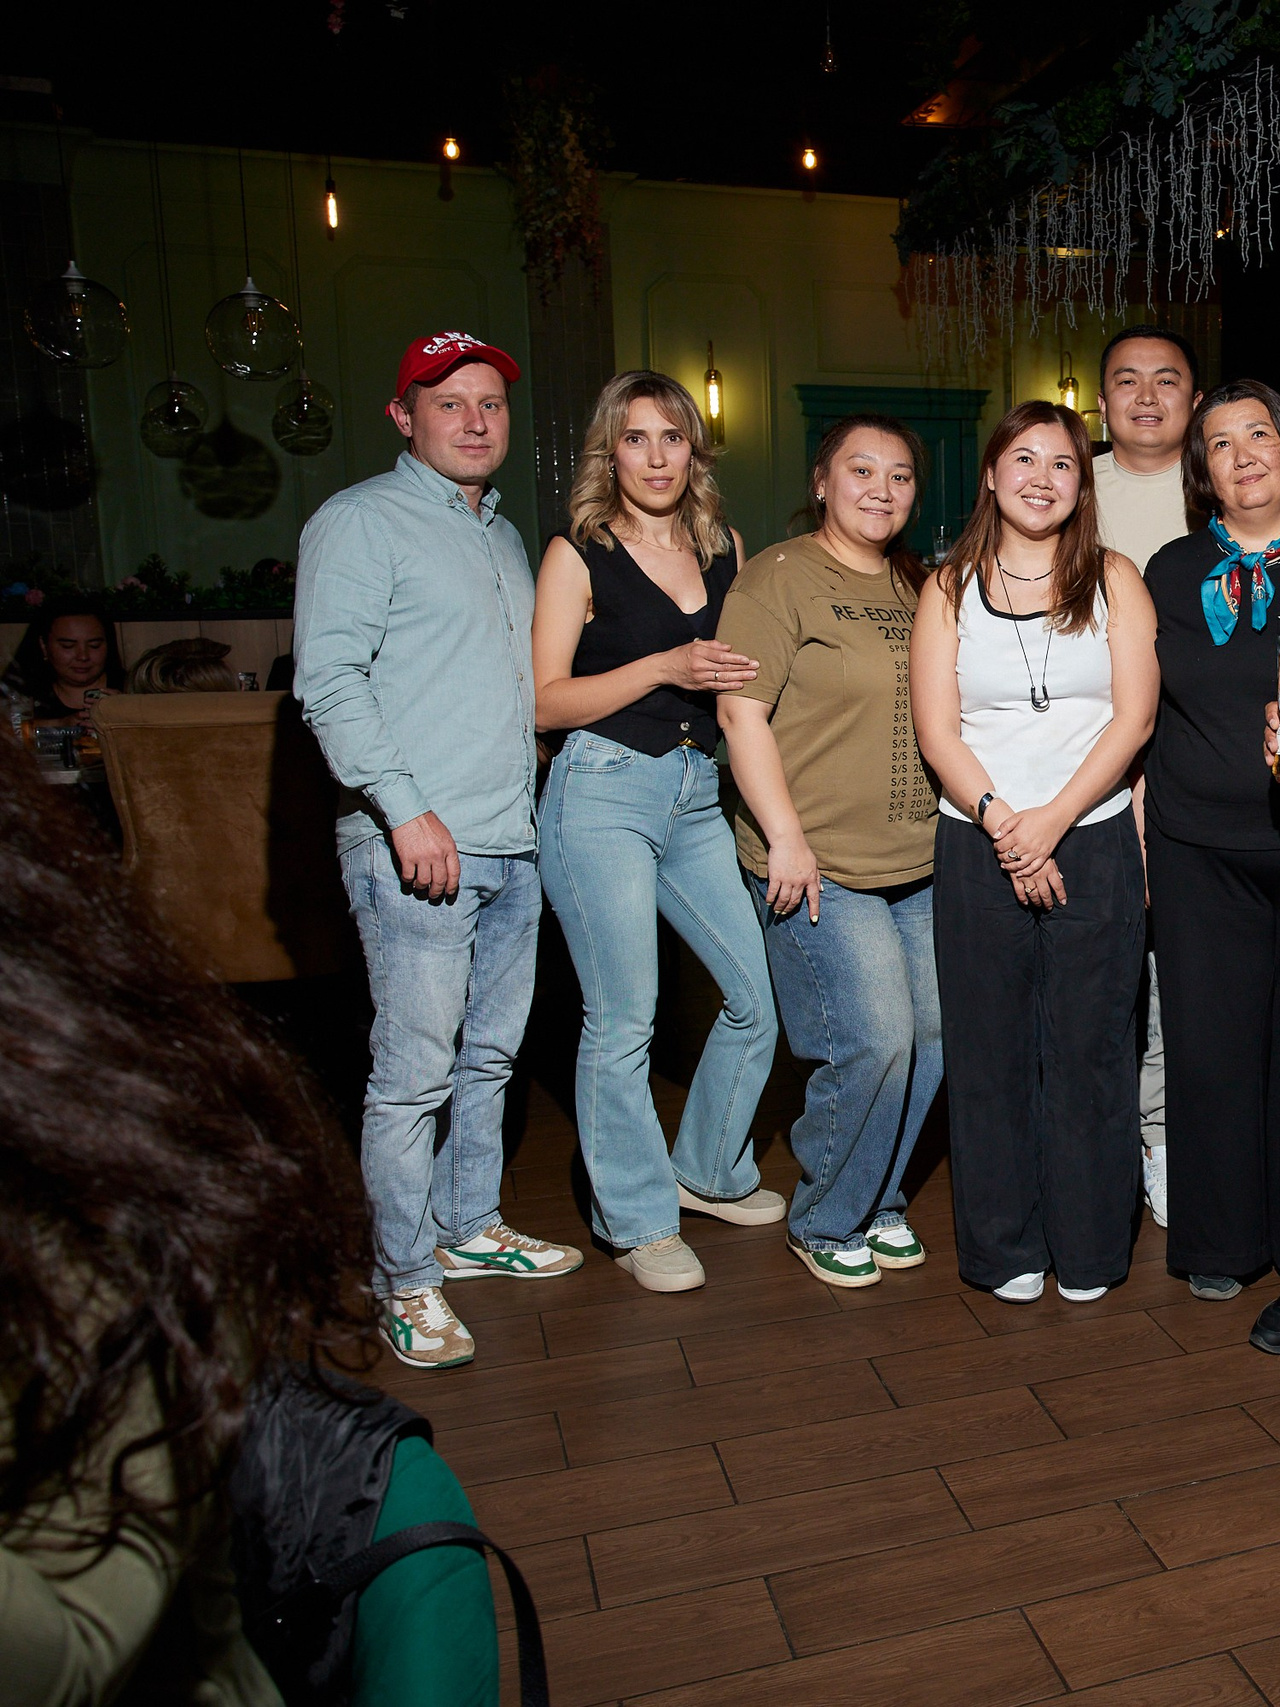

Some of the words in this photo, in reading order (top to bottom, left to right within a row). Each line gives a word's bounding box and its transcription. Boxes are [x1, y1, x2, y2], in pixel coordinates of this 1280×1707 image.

[895, 660, 908, 670] S/S
[896, 673, 909, 683] S/S
[895, 687, 908, 696] S/S
[894, 700, 908, 710] S/S
[893, 713, 908, 723] S/S
[892, 726, 908, 736] S/S
[892, 739, 908, 749] S/S
[891, 751, 908, 762] S/S
[891, 764, 908, 775] S/S
[891, 777, 908, 788] S/S
[890, 789, 906, 799] S/S
[888, 801, 905, 811] S/S
[910, 799, 932, 809] 2014
[887, 812, 903, 823] S/S
